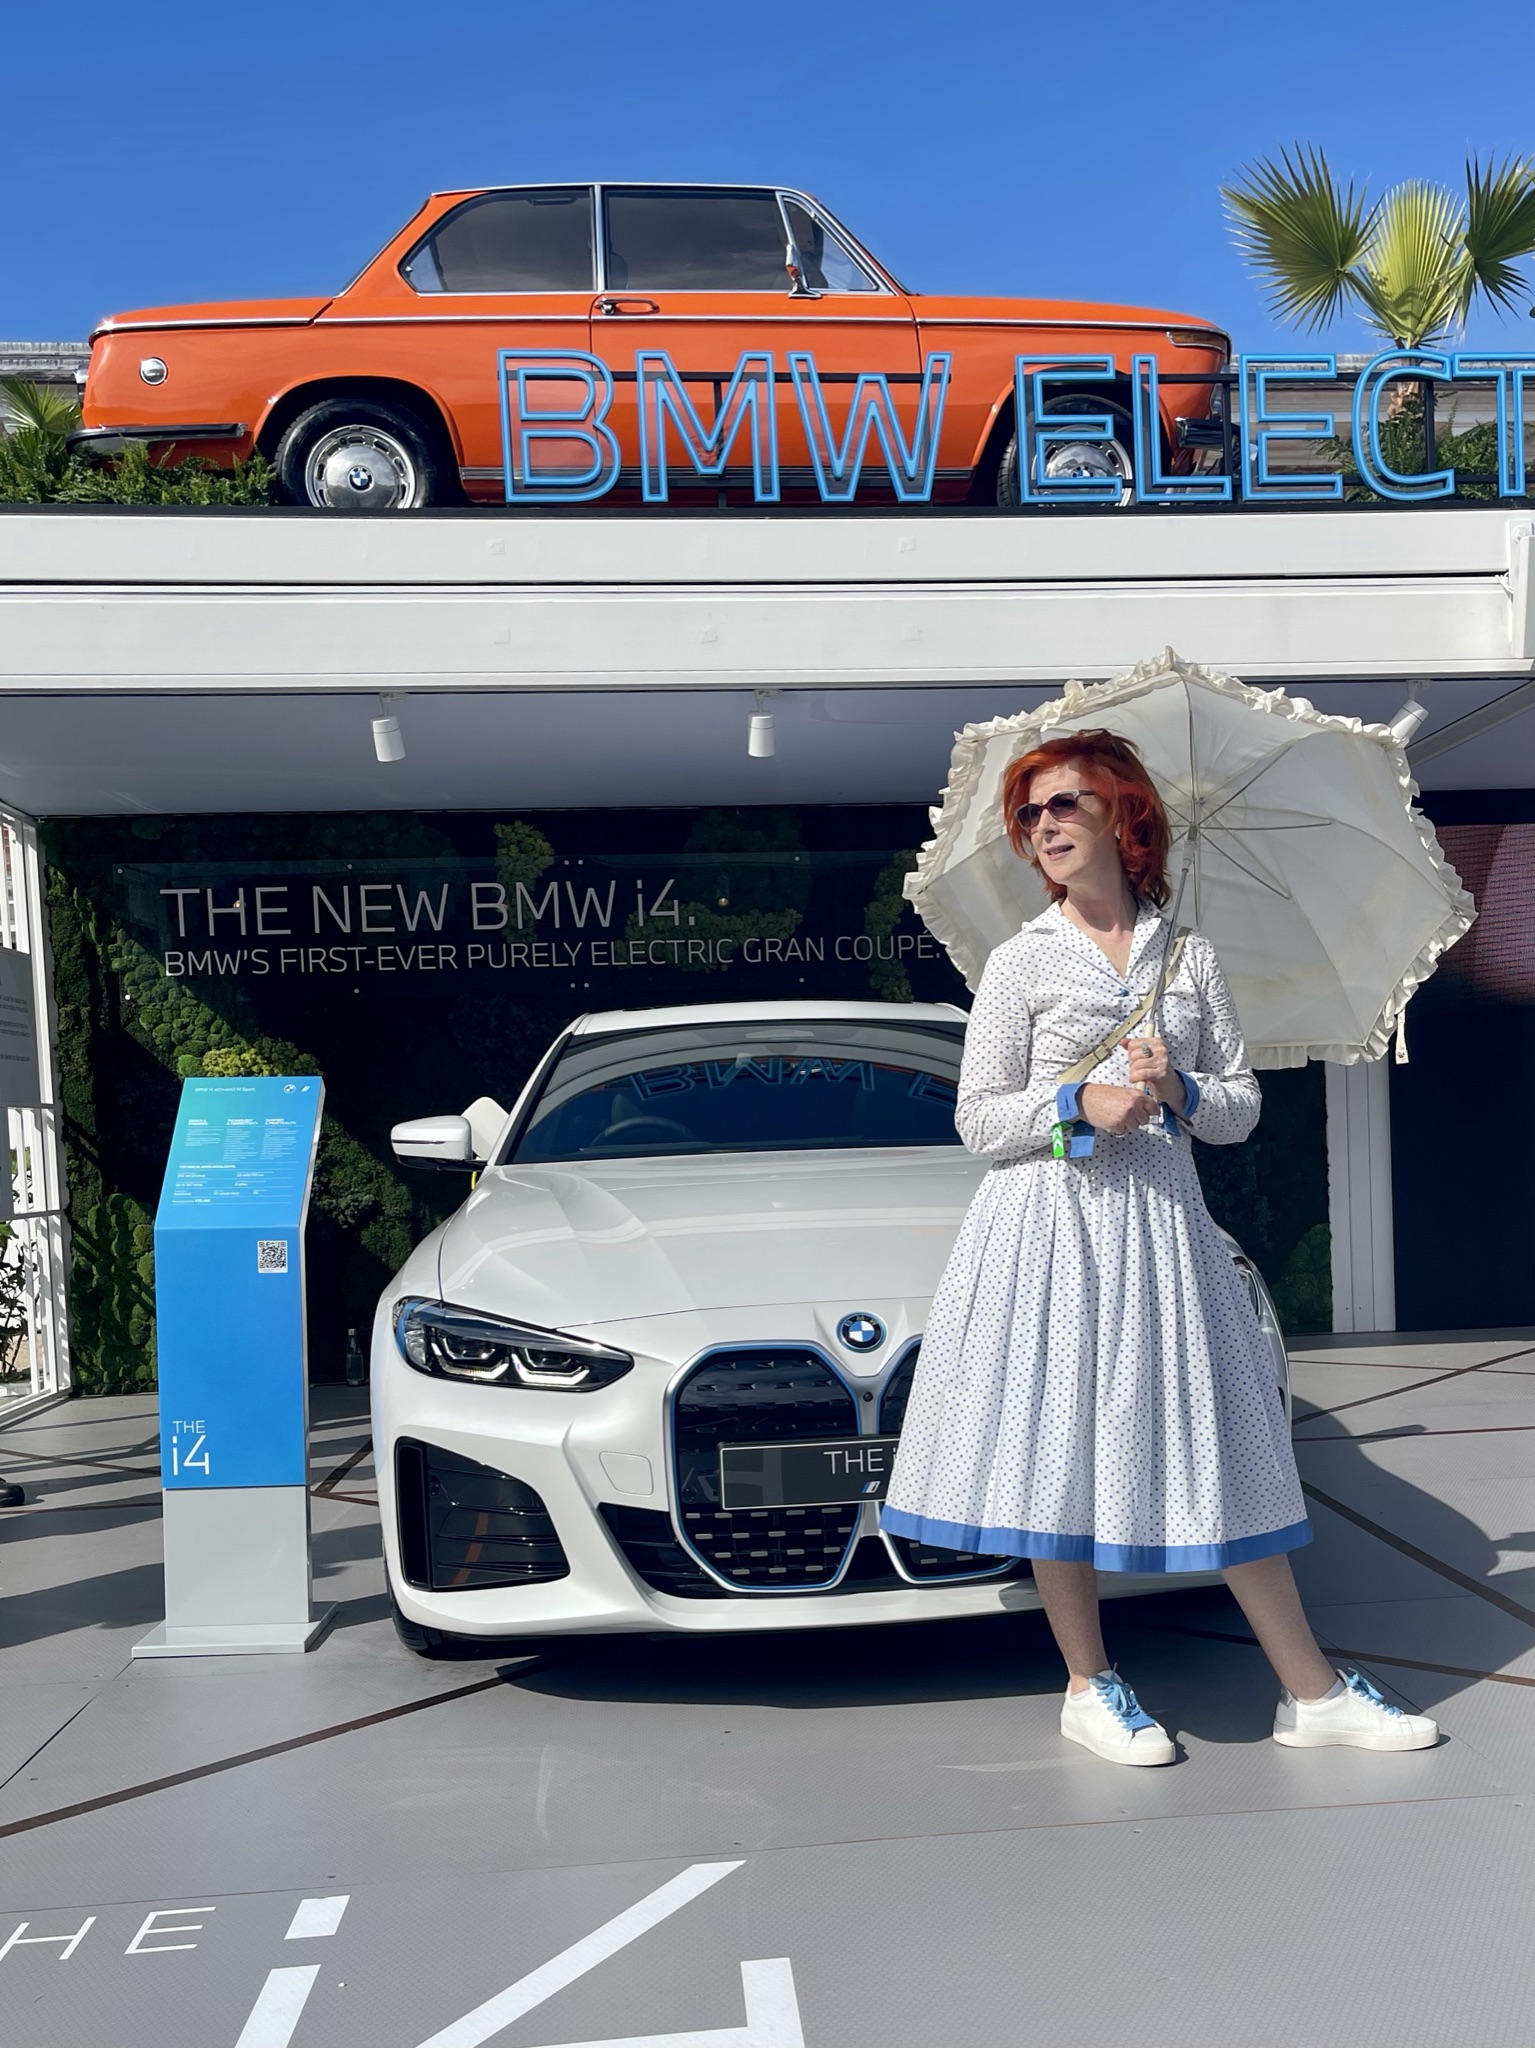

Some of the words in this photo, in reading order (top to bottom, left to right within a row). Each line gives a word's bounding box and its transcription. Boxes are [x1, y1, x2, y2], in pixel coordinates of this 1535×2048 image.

[497, 348, 954, 503] BMW
[1015, 348, 1535, 504] ELECT
[159, 886, 292, 937] THE
[312, 883, 449, 934] NEW
[470, 879, 616, 931] BMW
[636, 878, 696, 927] i4.
[164, 948, 270, 977] BMW'S
[280, 944, 458, 974] FIRST-EVER
[467, 941, 583, 970] PURELY
[591, 938, 735, 966] ELECTRIC
[742, 936, 825, 963] GRAN
[835, 930, 941, 961] COUPÉ.
[172, 1420, 206, 1434] THE
[172, 1435, 210, 1476] i4
[823, 1448, 885, 1475] THE
